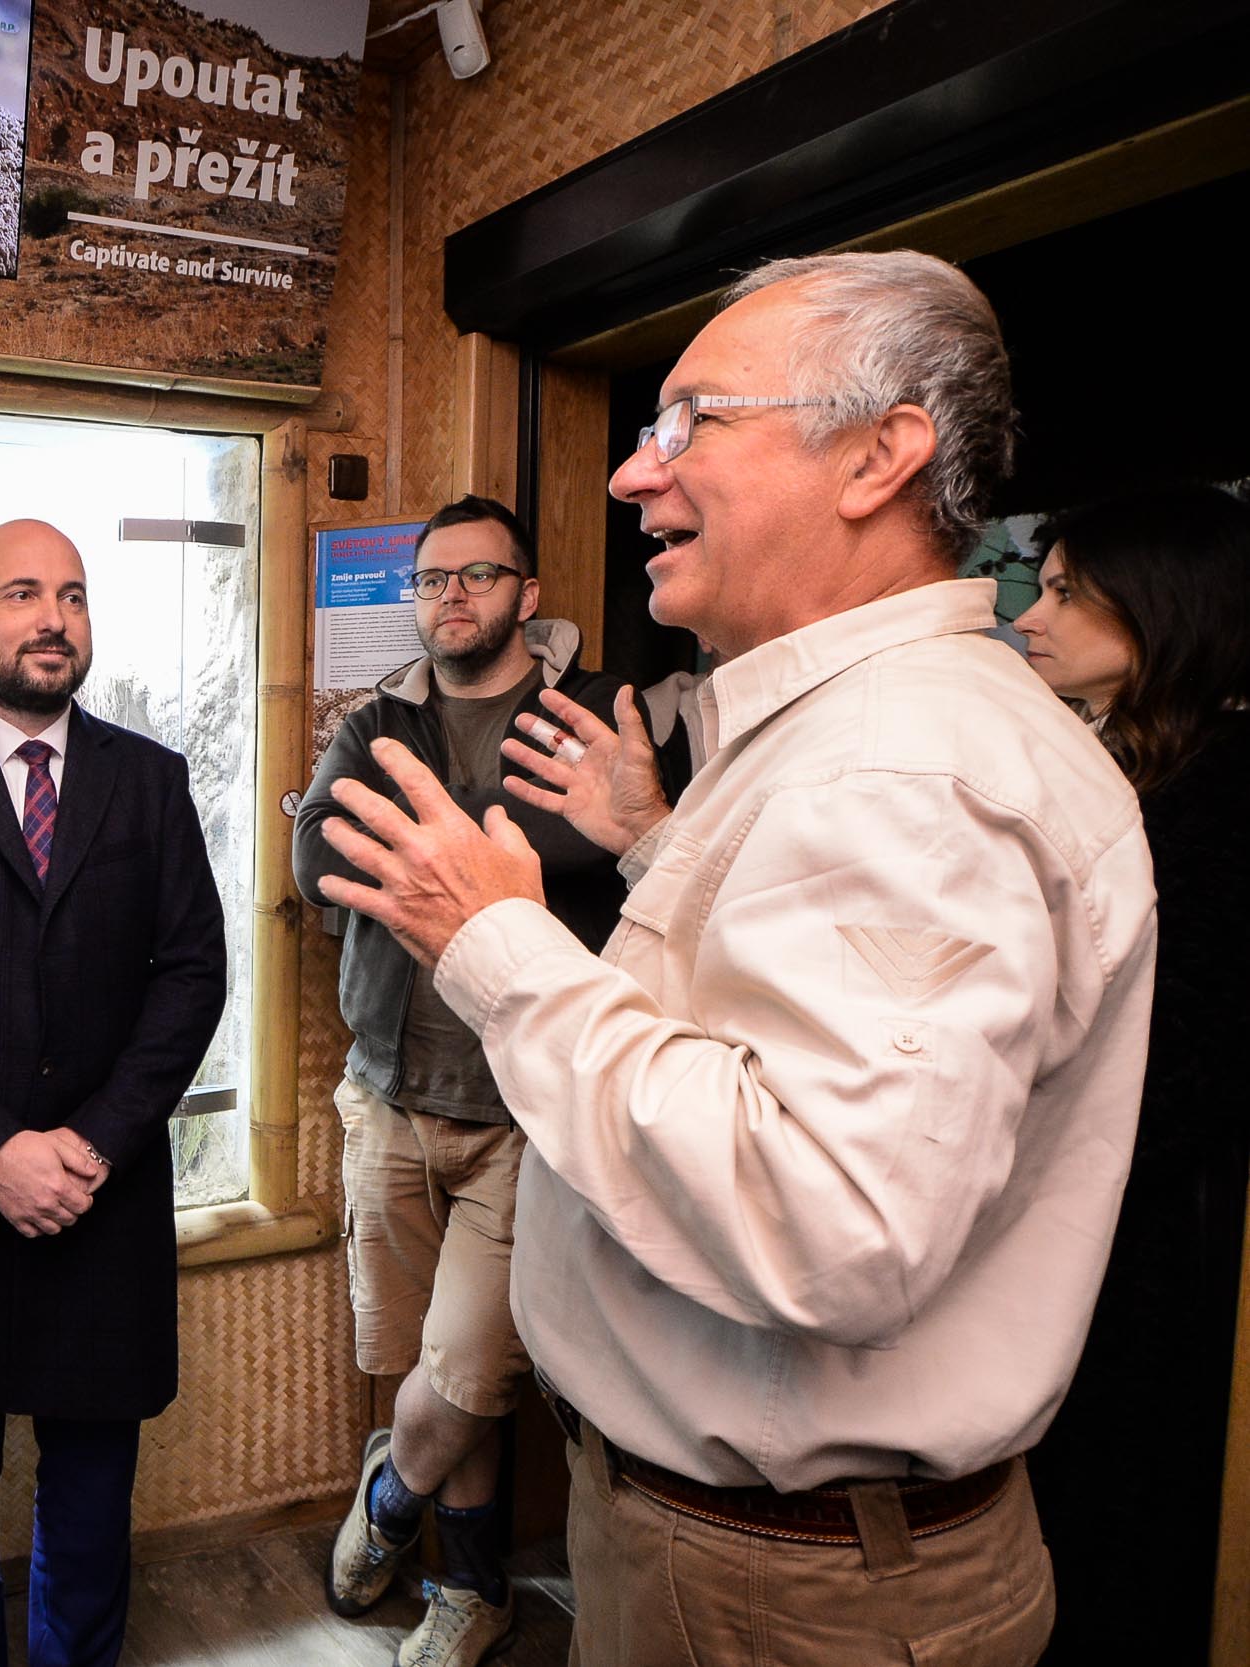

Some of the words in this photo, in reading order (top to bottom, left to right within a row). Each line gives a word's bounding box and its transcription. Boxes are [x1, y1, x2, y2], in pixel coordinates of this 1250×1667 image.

[84, 26, 305, 121] Upoutat
[80, 129, 116, 177] a
[134, 126, 299, 206] přežít
[70, 239, 170, 273] Captivate
[175, 257, 215, 280] and
[221, 261, 293, 290] Survive
[331, 573, 353, 582] Zmije
[354, 570, 386, 582] pavoučí
